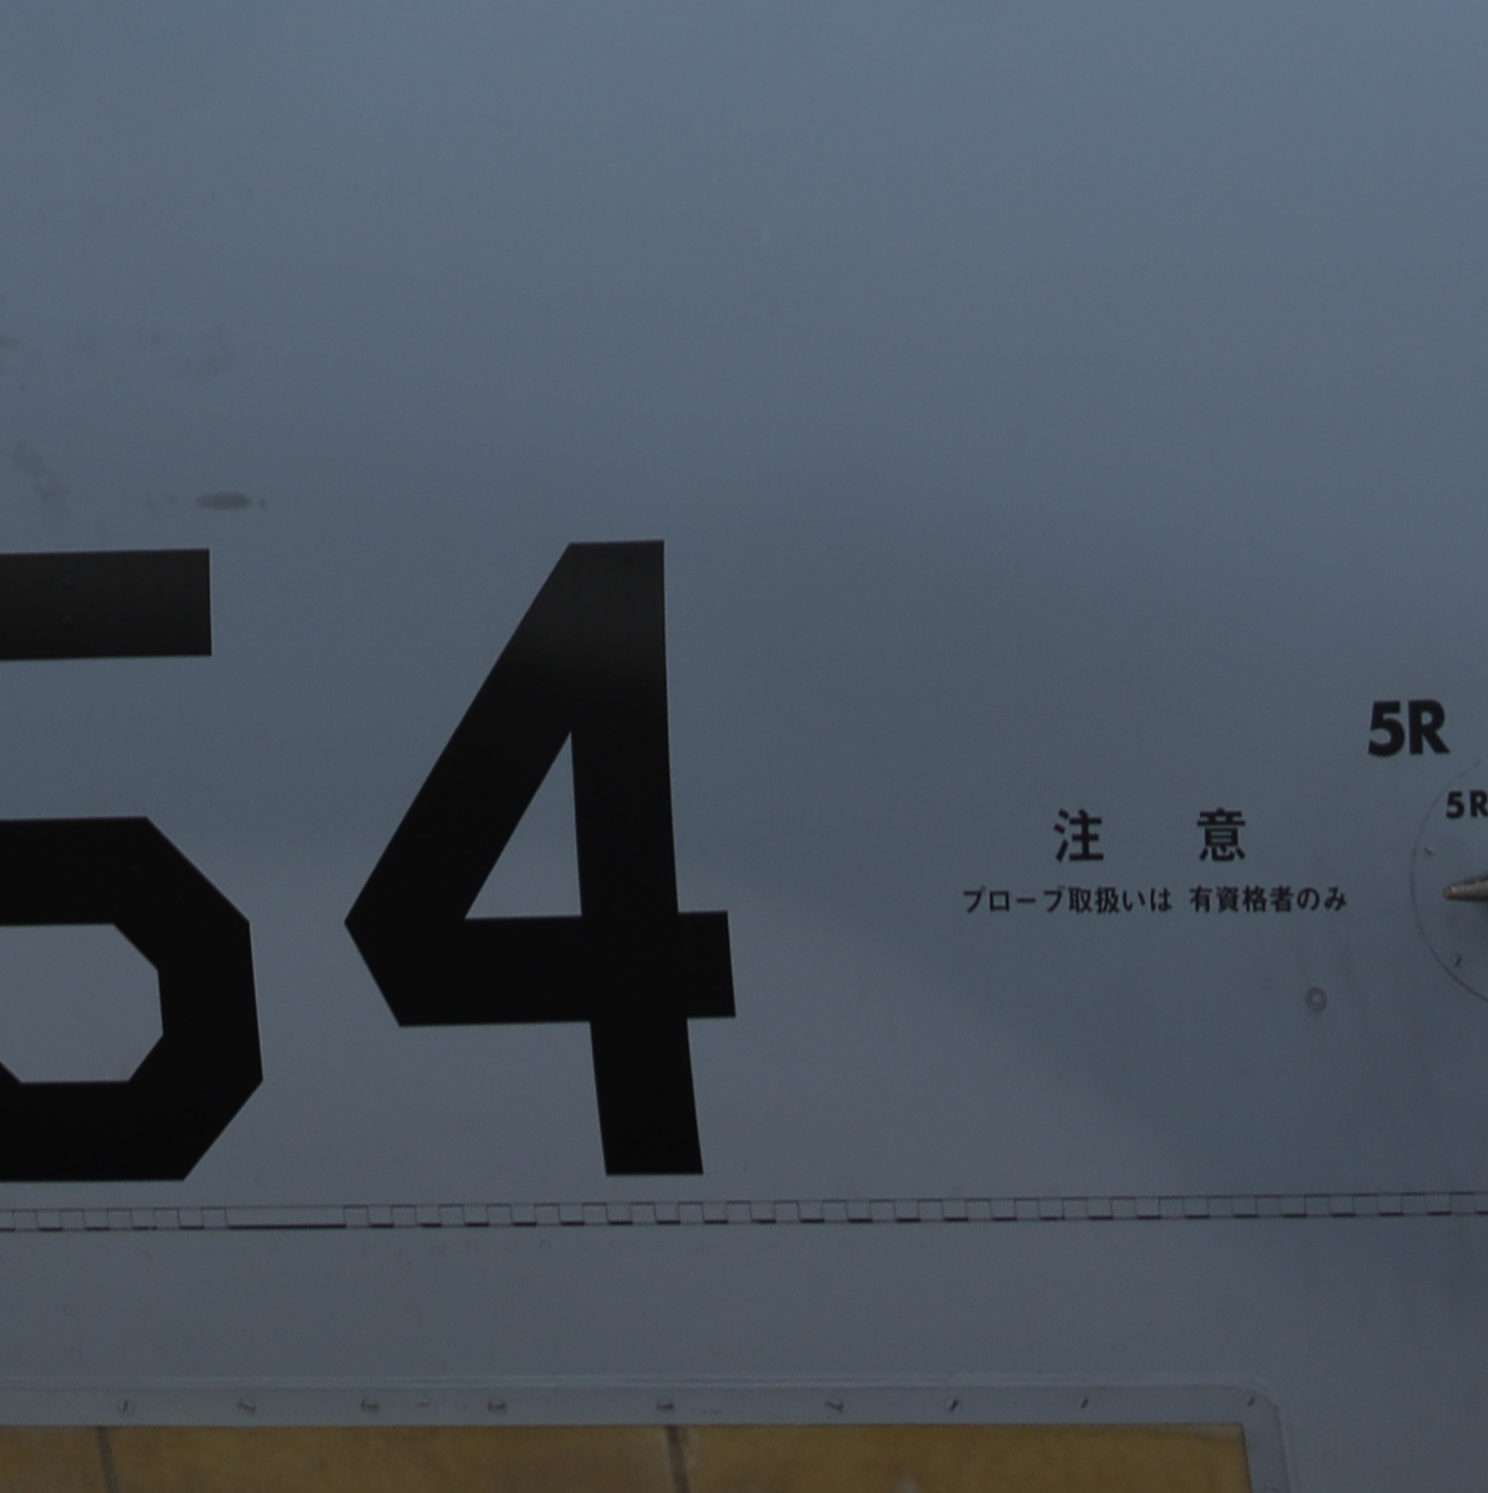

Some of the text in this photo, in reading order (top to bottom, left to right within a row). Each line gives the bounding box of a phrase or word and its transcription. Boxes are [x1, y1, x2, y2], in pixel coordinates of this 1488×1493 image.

[1368, 699, 1451, 757] 5R
[1189, 884, 1347, 914] 有資格者のみ
